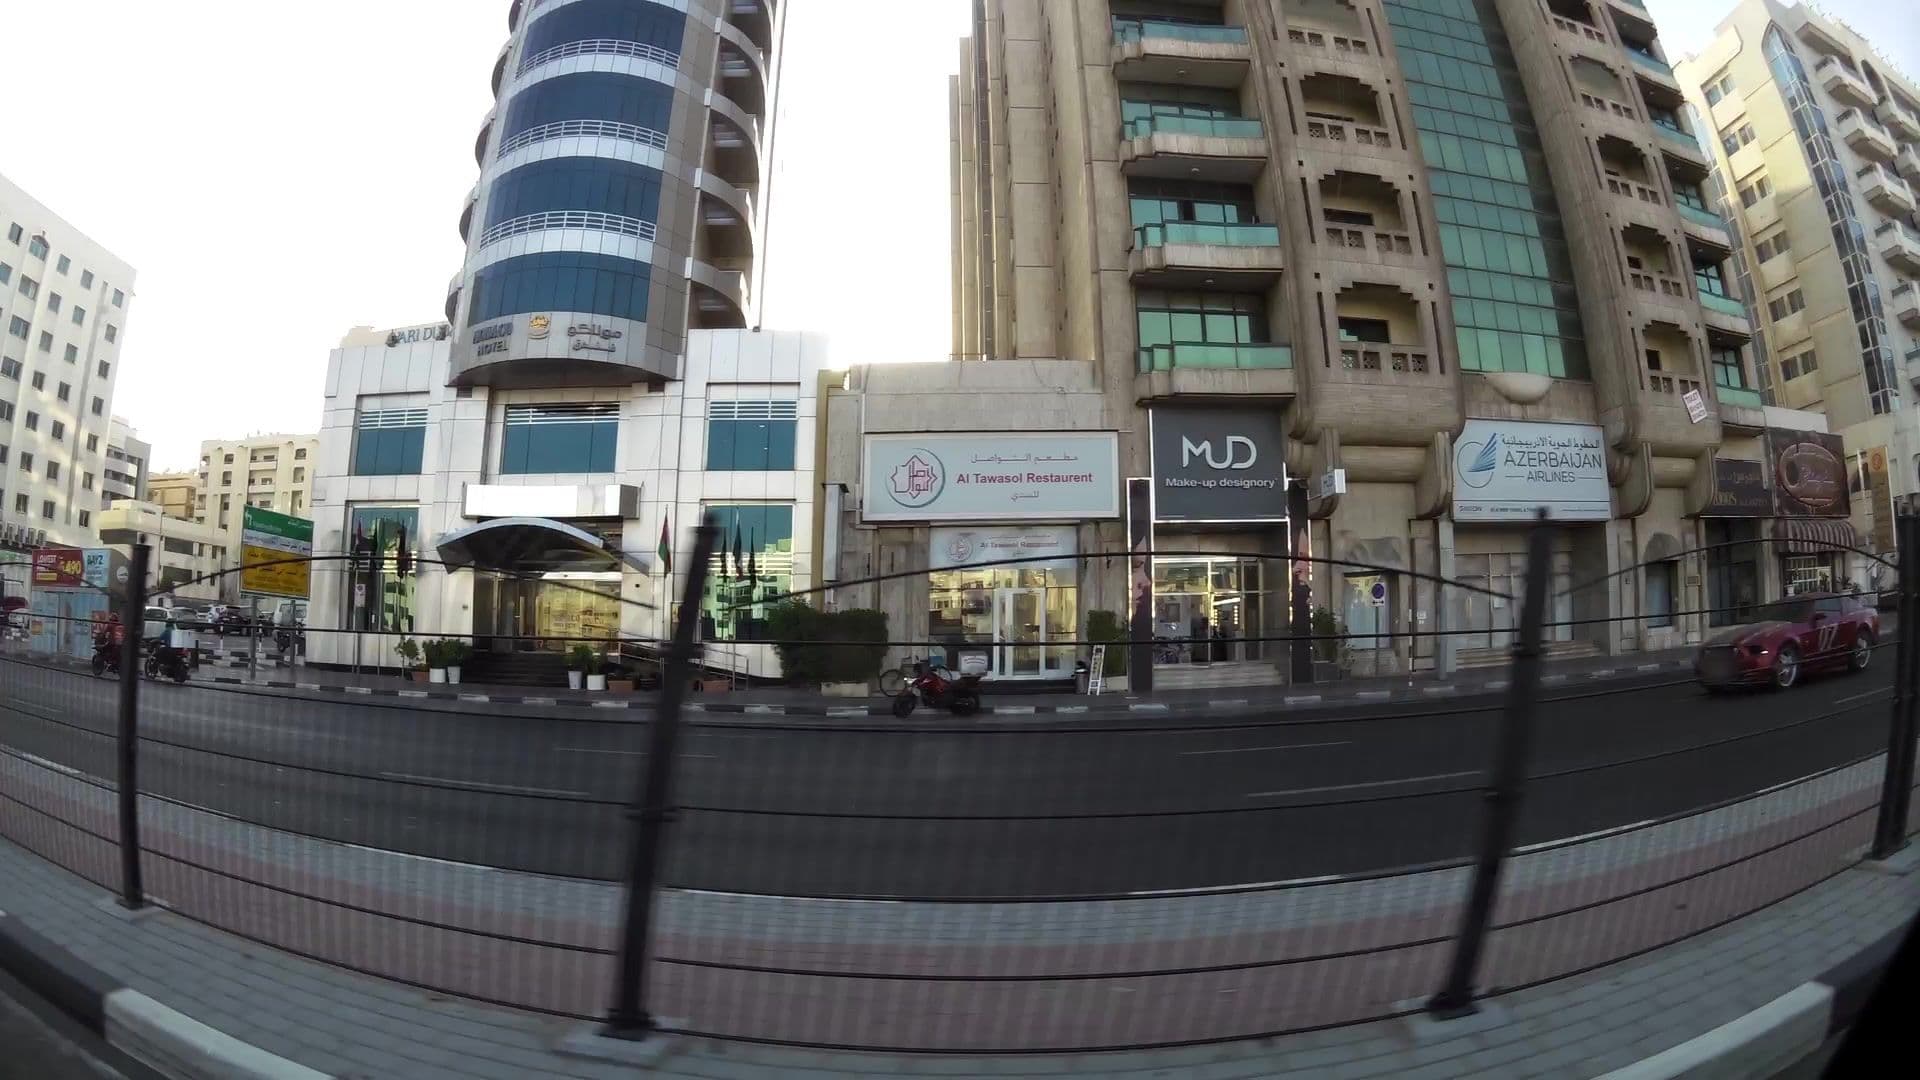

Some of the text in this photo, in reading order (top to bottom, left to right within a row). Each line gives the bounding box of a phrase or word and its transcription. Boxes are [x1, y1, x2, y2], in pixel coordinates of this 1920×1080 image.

[477, 340, 509, 357] HOTEL
[1182, 435, 1257, 469] MUD
[1504, 450, 1602, 469] AZERBAIJAN
[956, 472, 1093, 485] Al Tawasol Restaurent
[1166, 477, 1275, 489] Make-up designory
[1527, 470, 1576, 483] AIRLINES
